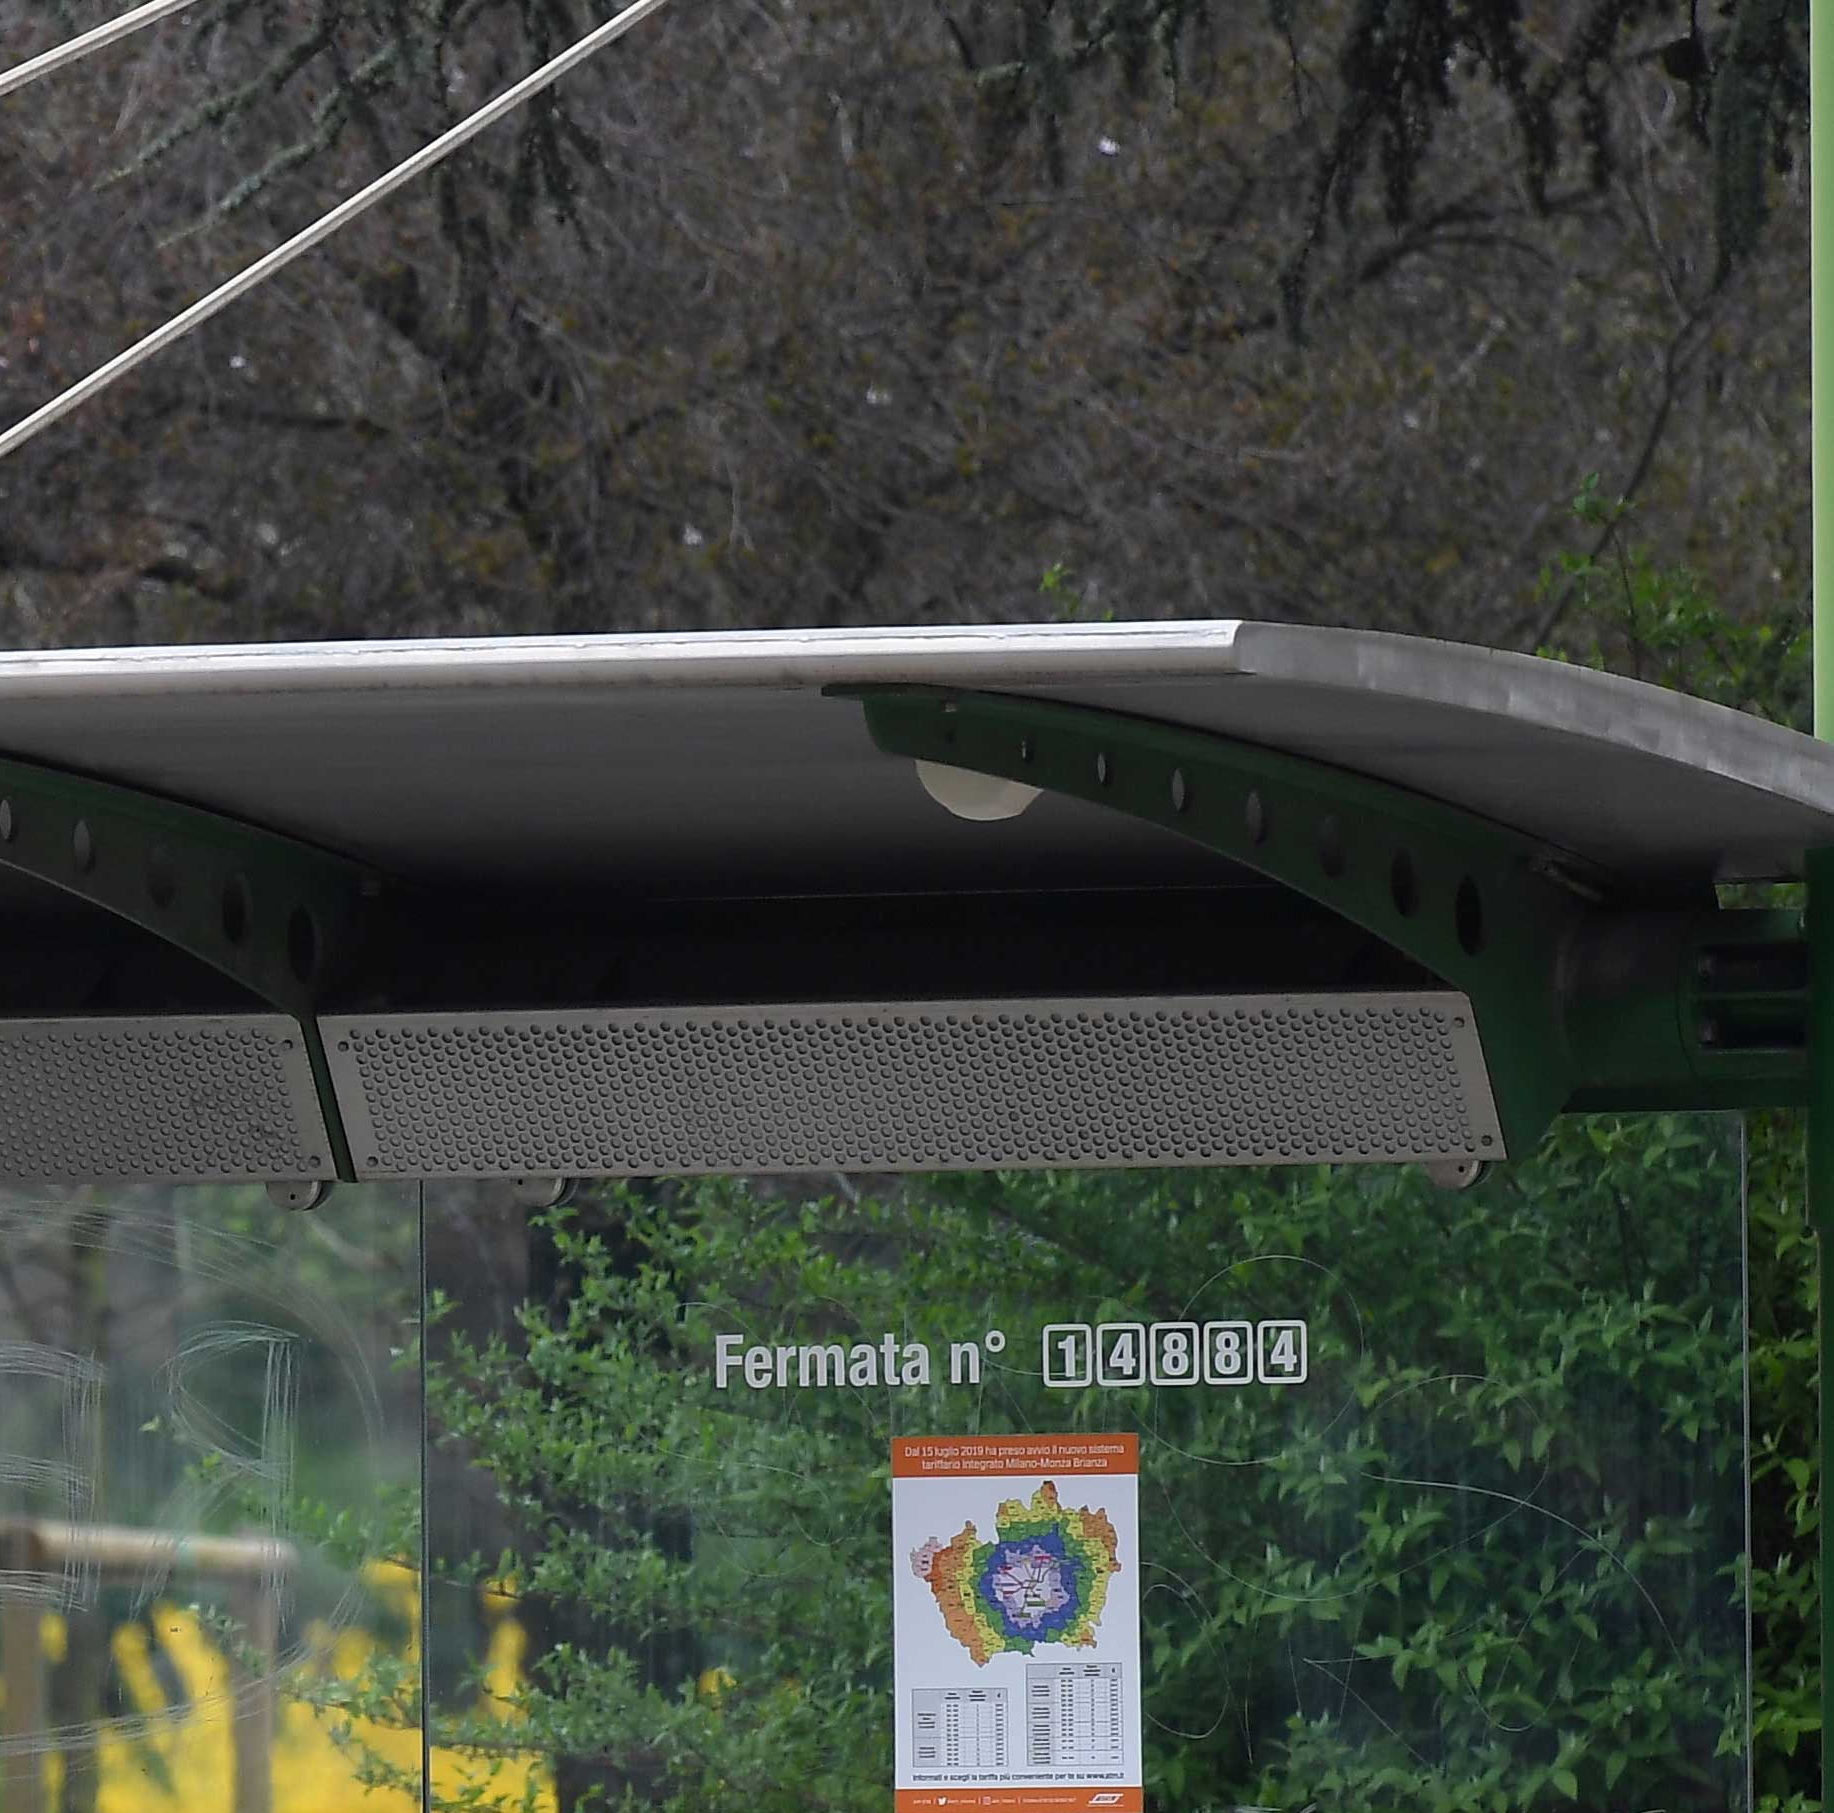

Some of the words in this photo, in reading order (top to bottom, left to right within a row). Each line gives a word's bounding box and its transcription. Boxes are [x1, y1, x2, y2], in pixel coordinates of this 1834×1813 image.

[714, 1333, 931, 1389] Fermata
[905, 1447, 919, 1457] Dal
[921, 1447, 933, 1457] 15
[935, 1446, 959, 1459] luglio
[960, 1446, 983, 1456] 2019
[985, 1446, 997, 1456] ha
[998, 1446, 1025, 1457] preso
[1027, 1445, 1050, 1455] avvio
[1059, 1446, 1087, 1455] nuovo
[1089, 1444, 1124, 1454] sistema
[1006, 1458, 1071, 1469] Milano-Monza
[1073, 1457, 1107, 1468] Brianza
